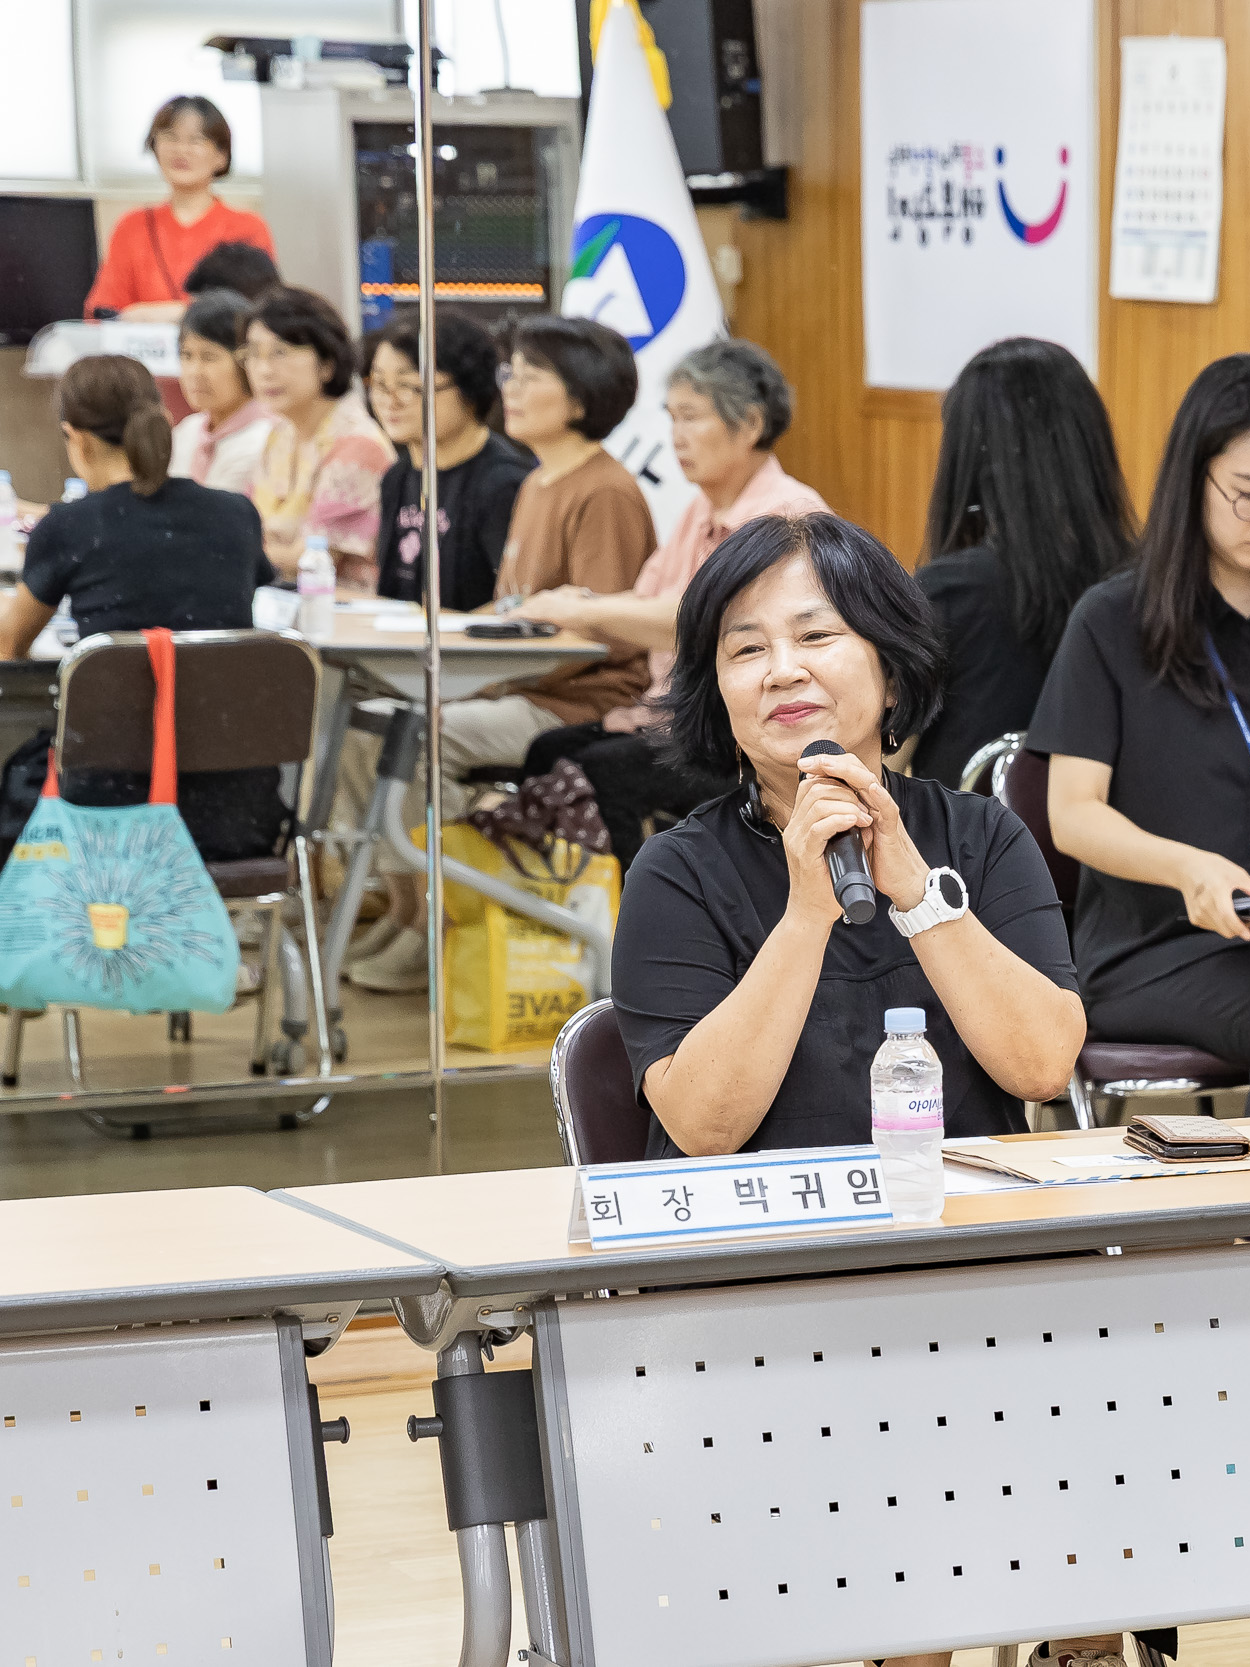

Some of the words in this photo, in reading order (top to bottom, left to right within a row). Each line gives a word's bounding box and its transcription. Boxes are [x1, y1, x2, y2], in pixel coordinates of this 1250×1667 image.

[590, 1191, 623, 1226] 회
[661, 1185, 694, 1223] 장
[733, 1177, 769, 1214] 박
[789, 1172, 826, 1210] 귀
[846, 1168, 882, 1206] 임
